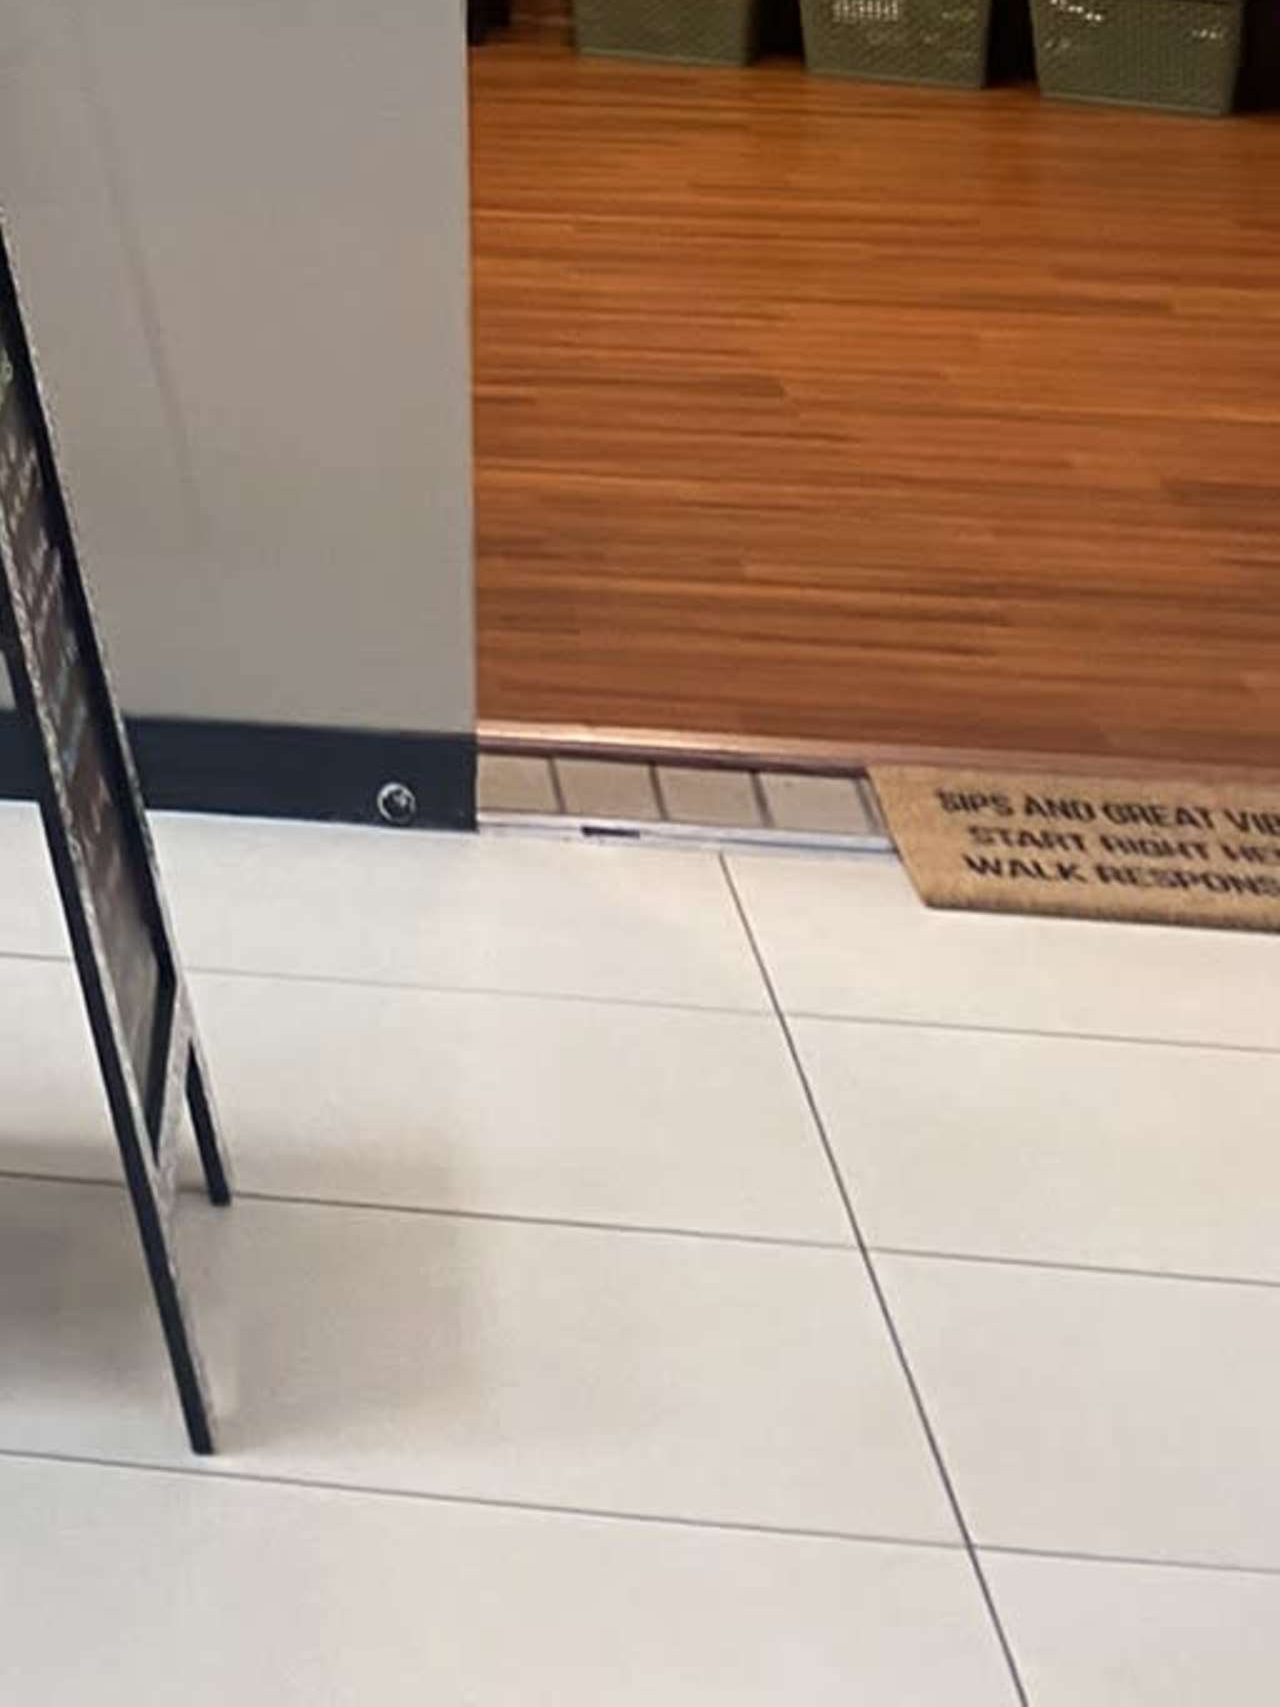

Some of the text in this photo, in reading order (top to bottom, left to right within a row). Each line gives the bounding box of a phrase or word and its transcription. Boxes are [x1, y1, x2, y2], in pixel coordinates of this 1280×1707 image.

[1023, 792, 1097, 822] AND
[1101, 801, 1214, 830] GREAT
[967, 825, 1087, 852] START
[961, 851, 1088, 882] WALK
